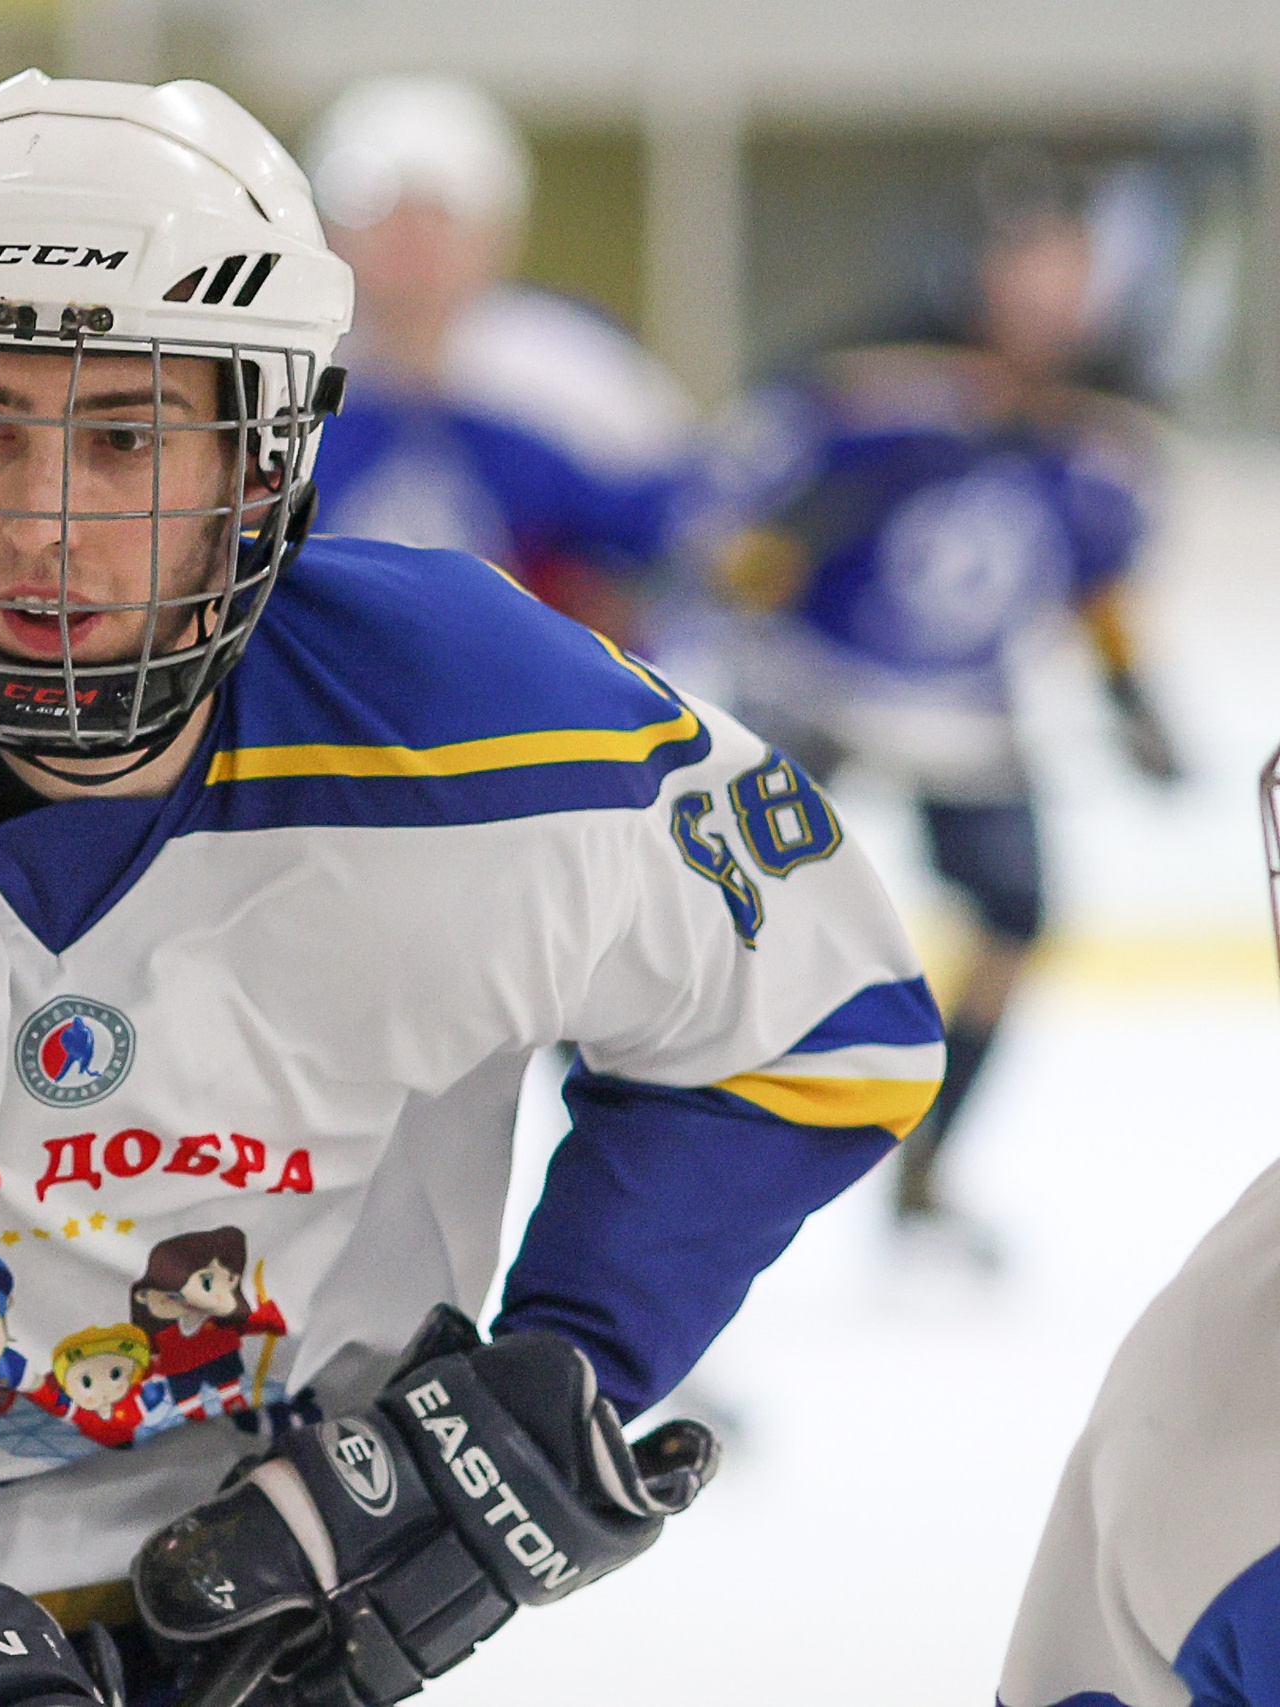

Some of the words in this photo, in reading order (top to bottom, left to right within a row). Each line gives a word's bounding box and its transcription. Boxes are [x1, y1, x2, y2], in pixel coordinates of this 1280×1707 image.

[4, 683, 99, 705] CCM
[670, 748, 843, 951] 68
[36, 1128, 314, 1202] ДОБРА
[404, 1378, 580, 1590] EASTON
